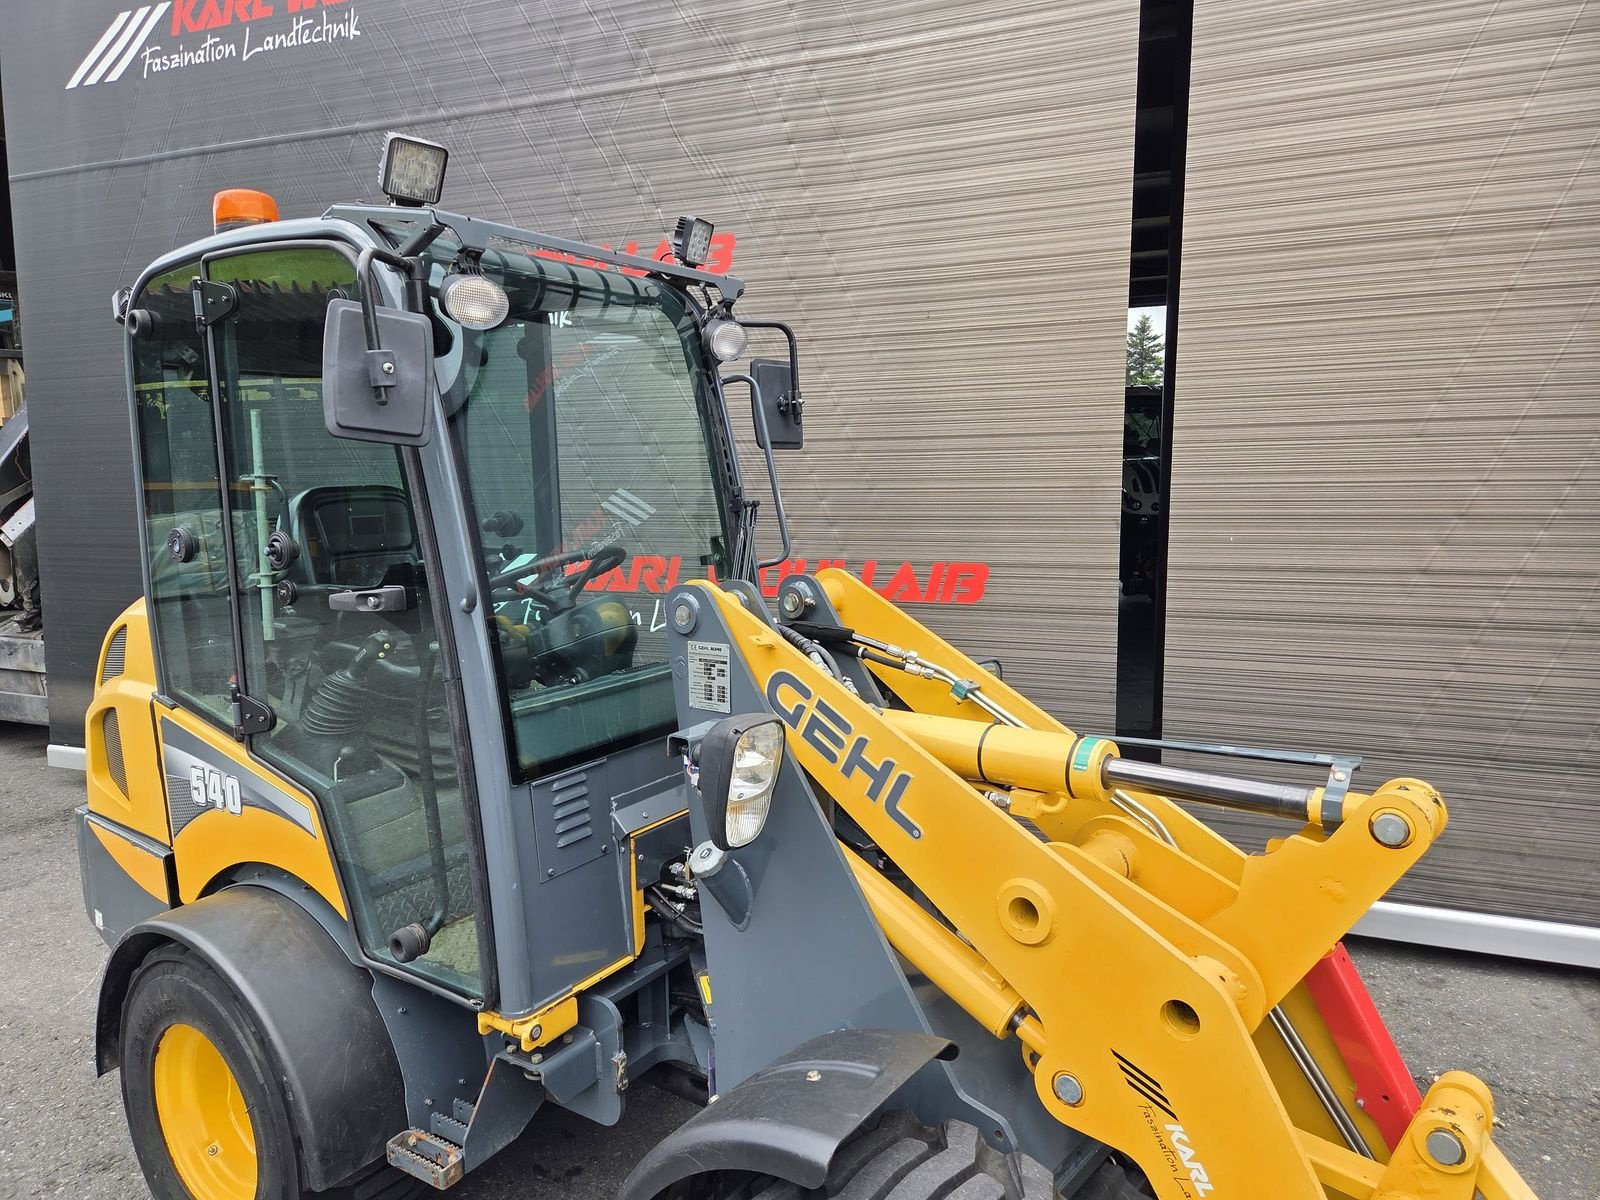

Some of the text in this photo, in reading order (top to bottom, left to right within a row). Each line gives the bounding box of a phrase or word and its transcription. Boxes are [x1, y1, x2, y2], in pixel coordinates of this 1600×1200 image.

[141, 7, 361, 79] Faszination Landtechnik
[190, 764, 243, 817] 540
[765, 668, 924, 841] GEHL
[1137, 1101, 1178, 1173] Faszination
[1163, 1124, 1214, 1197] KARL
